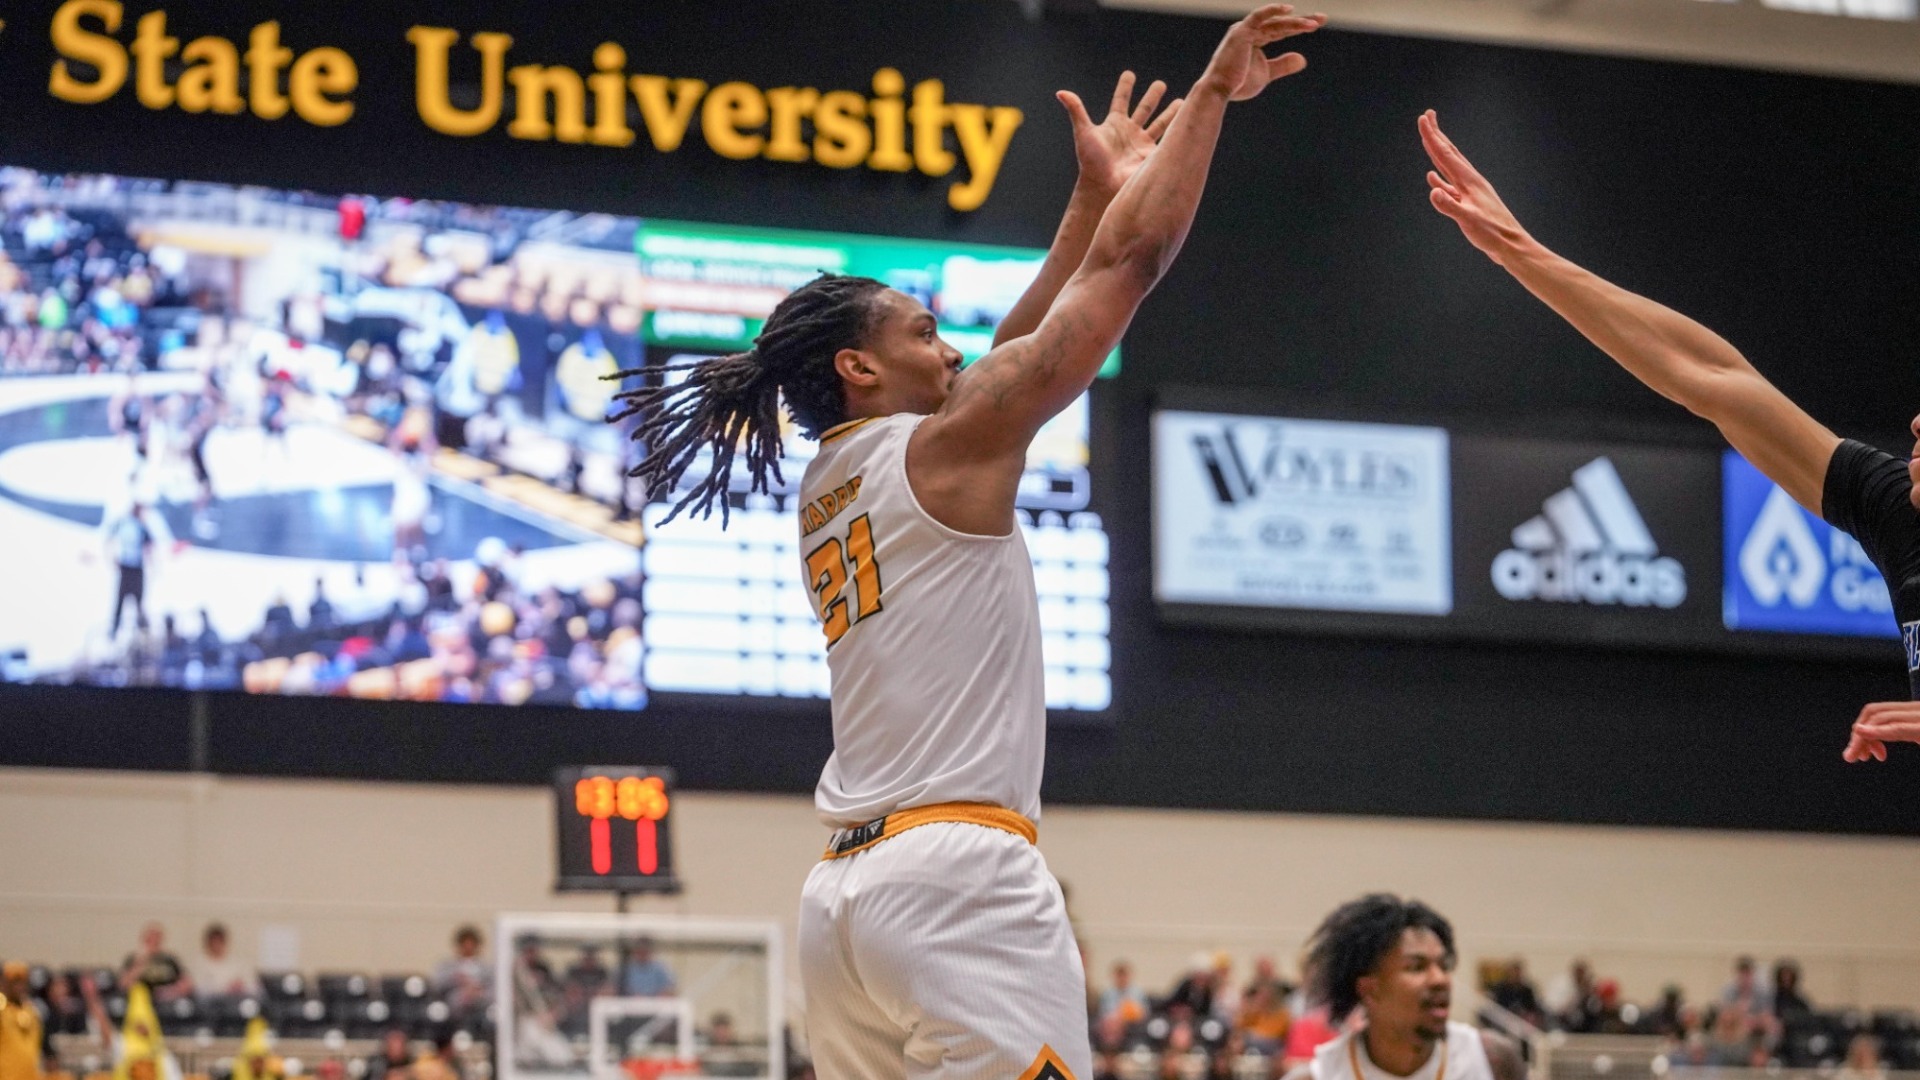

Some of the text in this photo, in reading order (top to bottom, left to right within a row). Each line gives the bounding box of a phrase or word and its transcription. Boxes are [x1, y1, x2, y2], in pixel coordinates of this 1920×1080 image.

[50, 0, 1023, 211] State University
[805, 511, 883, 651] 21
[1491, 548, 1687, 609] adidas
[590, 817, 658, 875] 11
